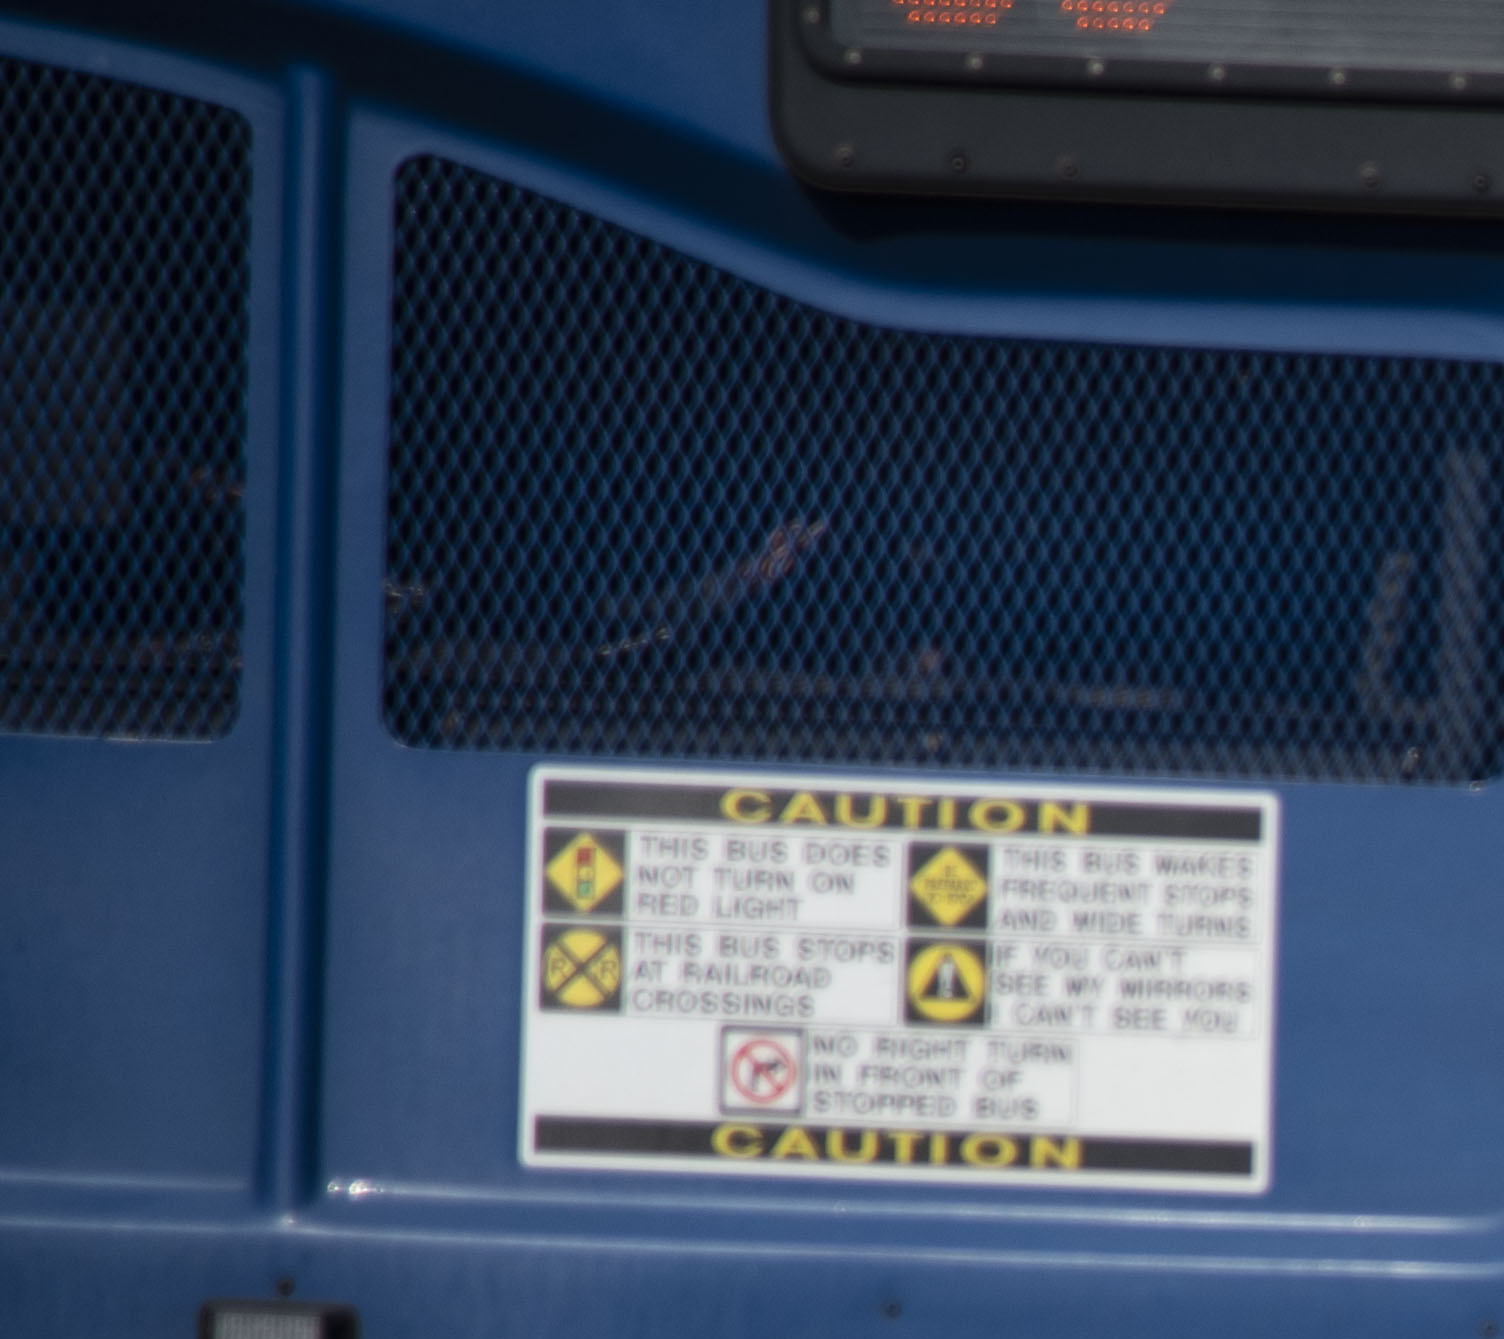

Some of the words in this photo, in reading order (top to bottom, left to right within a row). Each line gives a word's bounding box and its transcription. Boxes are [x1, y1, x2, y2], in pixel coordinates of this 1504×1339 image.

[720, 789, 1092, 834] CAUTION
[638, 835, 709, 862] THIS
[725, 839, 789, 864] BUS
[804, 843, 892, 868] DOES
[1002, 849, 1066, 873] THIS
[1083, 851, 1141, 875] BUS
[637, 865, 698, 888] NOT
[714, 867, 795, 892] TURN
[811, 871, 856, 895] ON
[1001, 878, 1152, 903] FREQUENT
[1164, 884, 1253, 908] STOPS
[636, 893, 699, 916] RED
[714, 896, 803, 920] LIGHT
[1001, 908, 1058, 932] AND
[1073, 911, 1143, 935] WIDE
[1156, 913, 1251, 938] TURNS
[634, 931, 702, 957] THIS
[718, 935, 781, 960] BUS
[798, 938, 895, 964] STOPS
[996, 945, 1018, 968] IF
[1033, 947, 1089, 970] YOU
[1105, 947, 1188, 971] CAN'T
[634, 959, 667, 983] AT
[682, 962, 833, 989] RAILROAD
[994, 973, 1049, 997] SEE
[631, 988, 816, 1018] CROSSINGS
[1113, 1006, 1168, 1031] SEE
[1183, 1009, 1239, 1033] YOU
[814, 1034, 858, 1058] NO
[875, 1037, 970, 1061] RIGHT
[986, 1040, 1072, 1065] TURN
[814, 1063, 841, 1083] IN
[859, 1064, 963, 1088] FRONT
[981, 1068, 1023, 1091] OF
[814, 1090, 958, 1118] STOPPED
[973, 1097, 1039, 1121] BUS
[712, 1125, 1084, 1170] CAUTION
